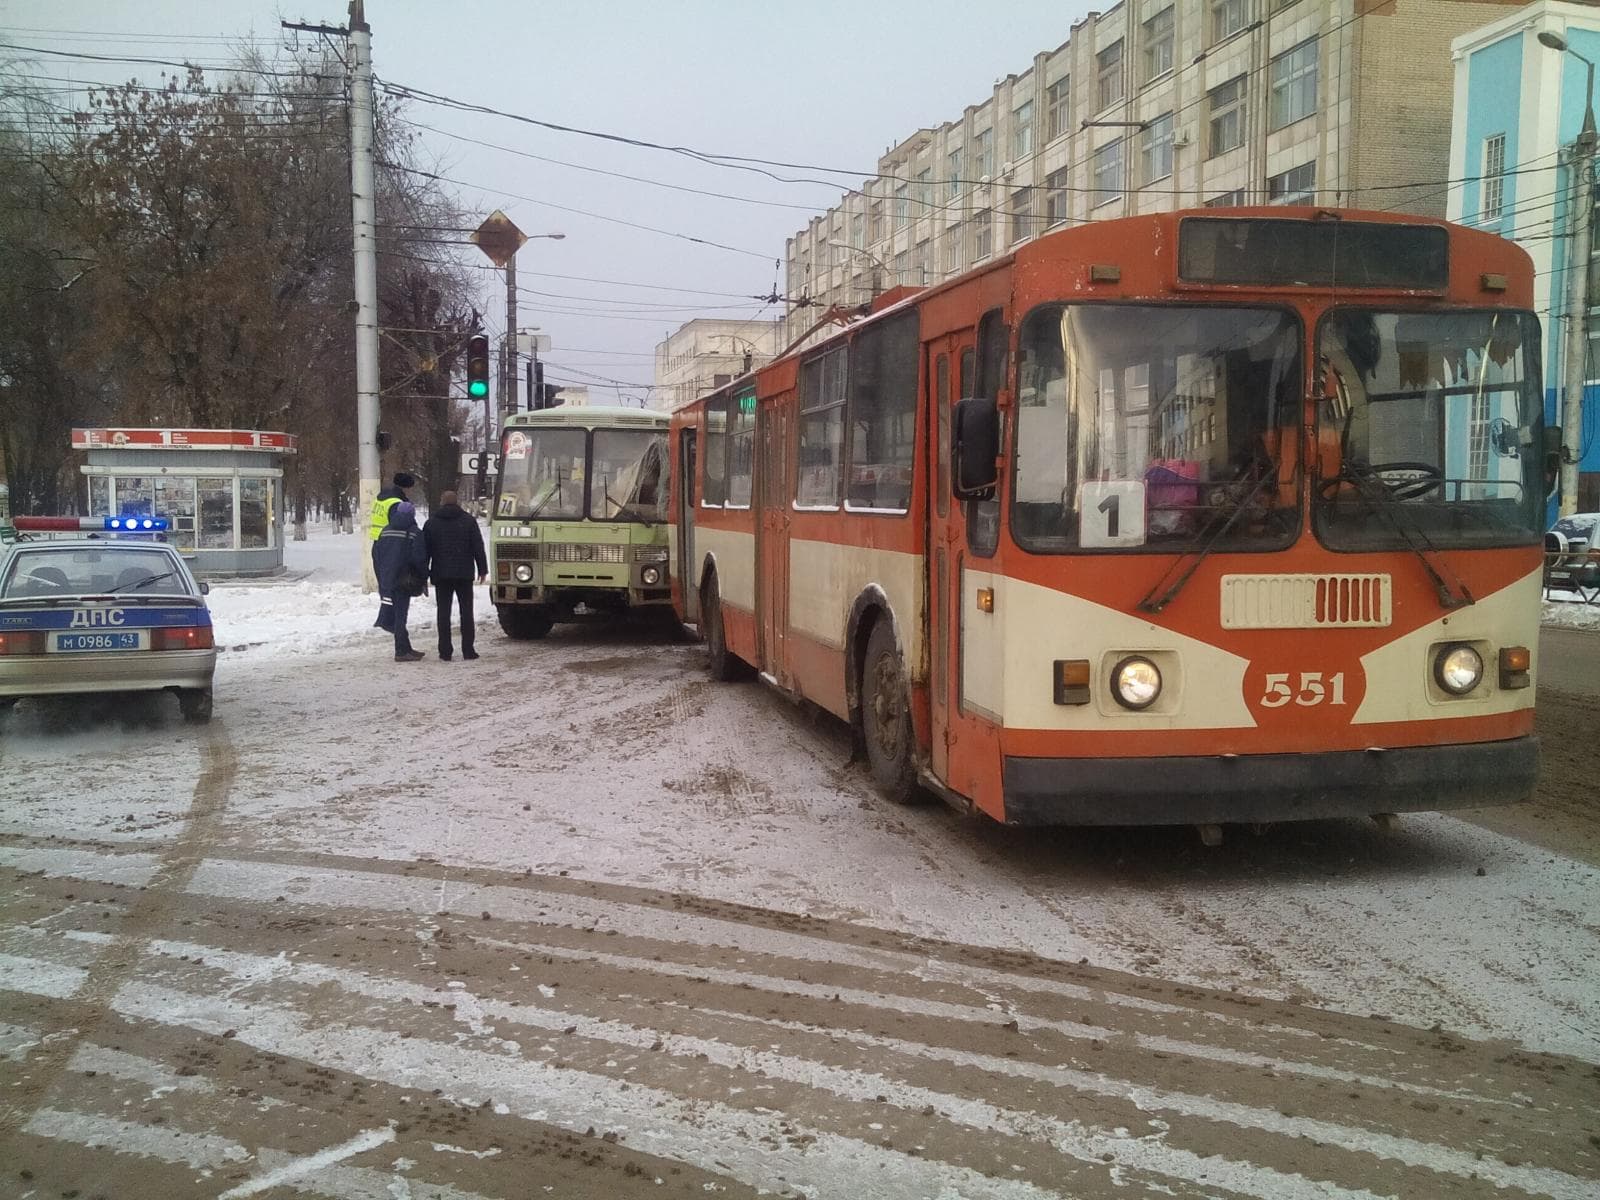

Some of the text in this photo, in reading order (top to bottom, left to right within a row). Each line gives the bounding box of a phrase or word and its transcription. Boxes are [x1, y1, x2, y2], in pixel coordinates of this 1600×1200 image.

[501, 499, 513, 515] 74
[1097, 494, 1120, 538] 1
[70, 608, 125, 628] ДПС
[77, 635, 113, 649] 0986
[120, 633, 135, 644] 43
[1260, 672, 1347, 708] 551
